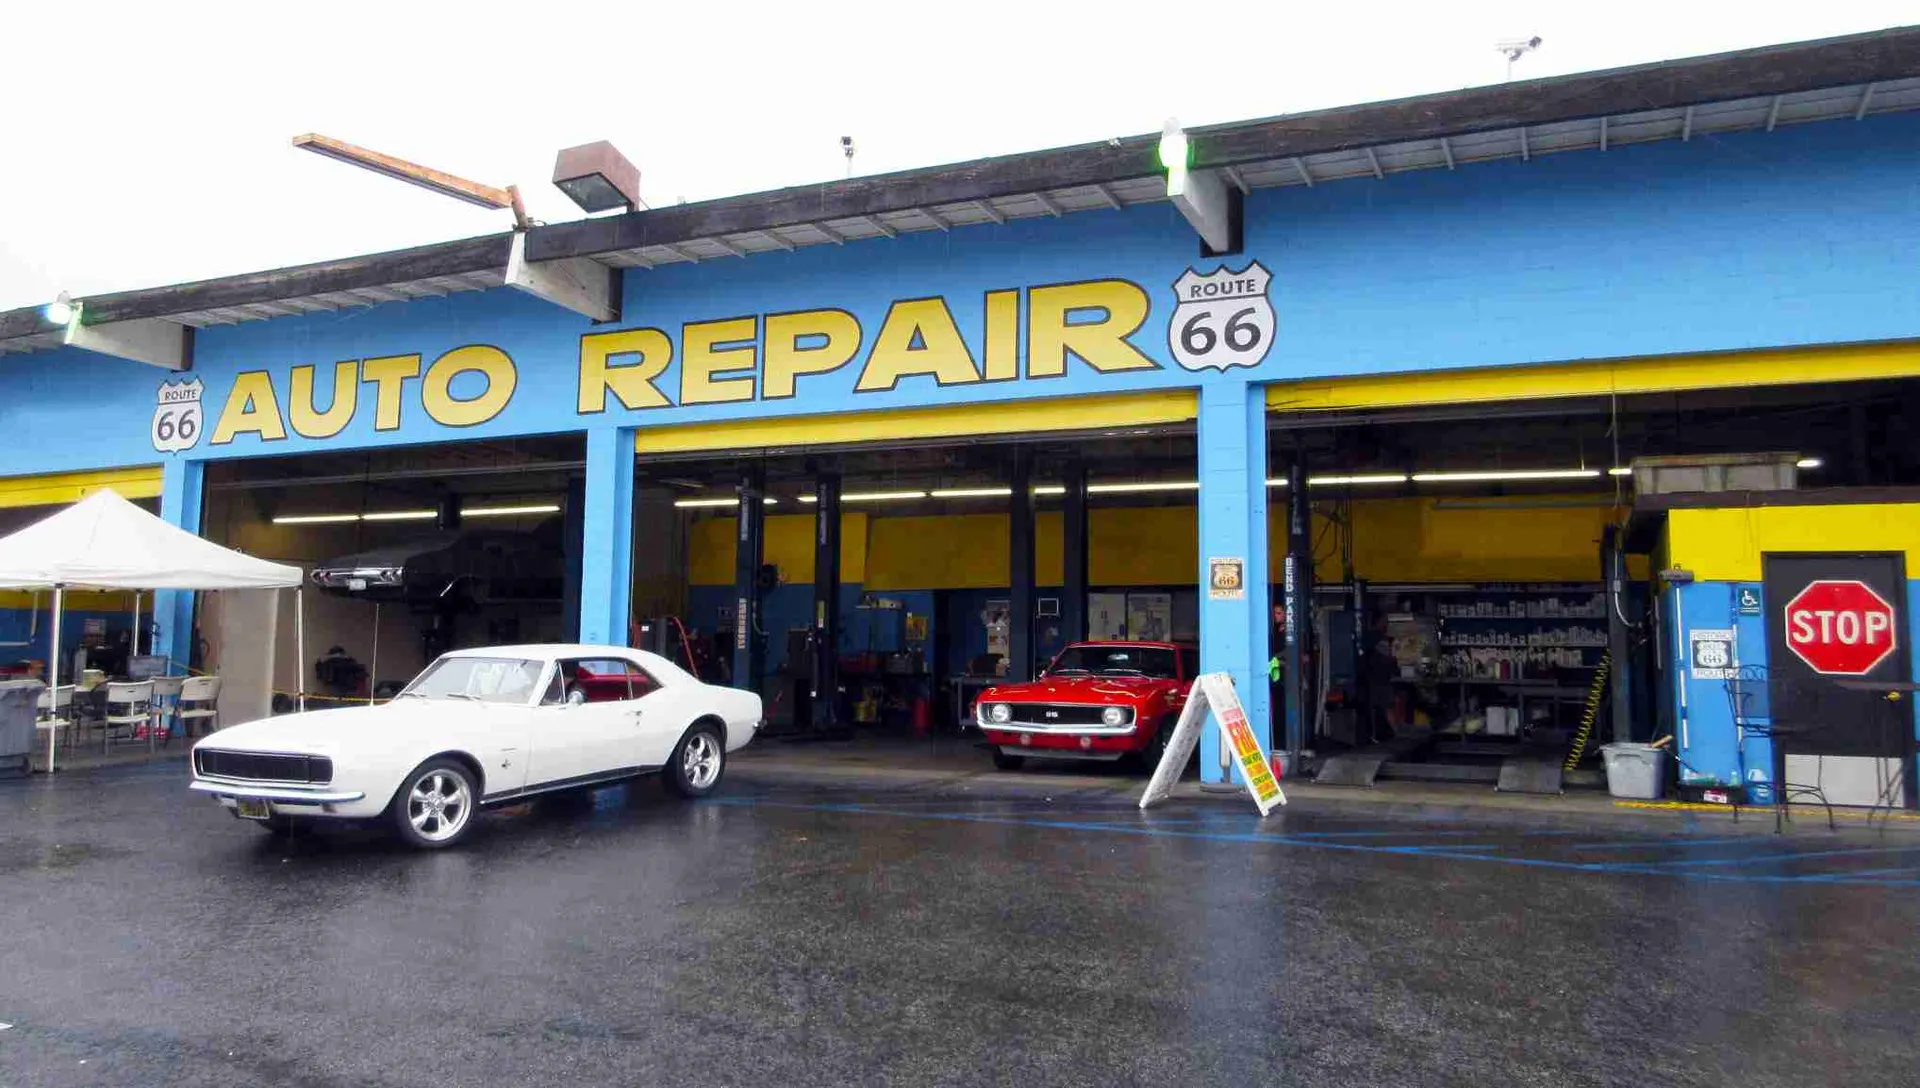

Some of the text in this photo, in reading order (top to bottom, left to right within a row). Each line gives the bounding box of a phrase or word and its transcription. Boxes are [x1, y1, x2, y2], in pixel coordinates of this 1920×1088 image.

[1190, 279, 1256, 298] ROUTE
[1181, 307, 1261, 356] 66
[209, 278, 1165, 445] AUTO REPAIR
[165, 389, 197, 401] ROUTE
[157, 409, 196, 441] 66
[1285, 557, 1294, 592] BEND
[1792, 610, 1888, 645] STOP
[1703, 654, 1722, 664] 66
